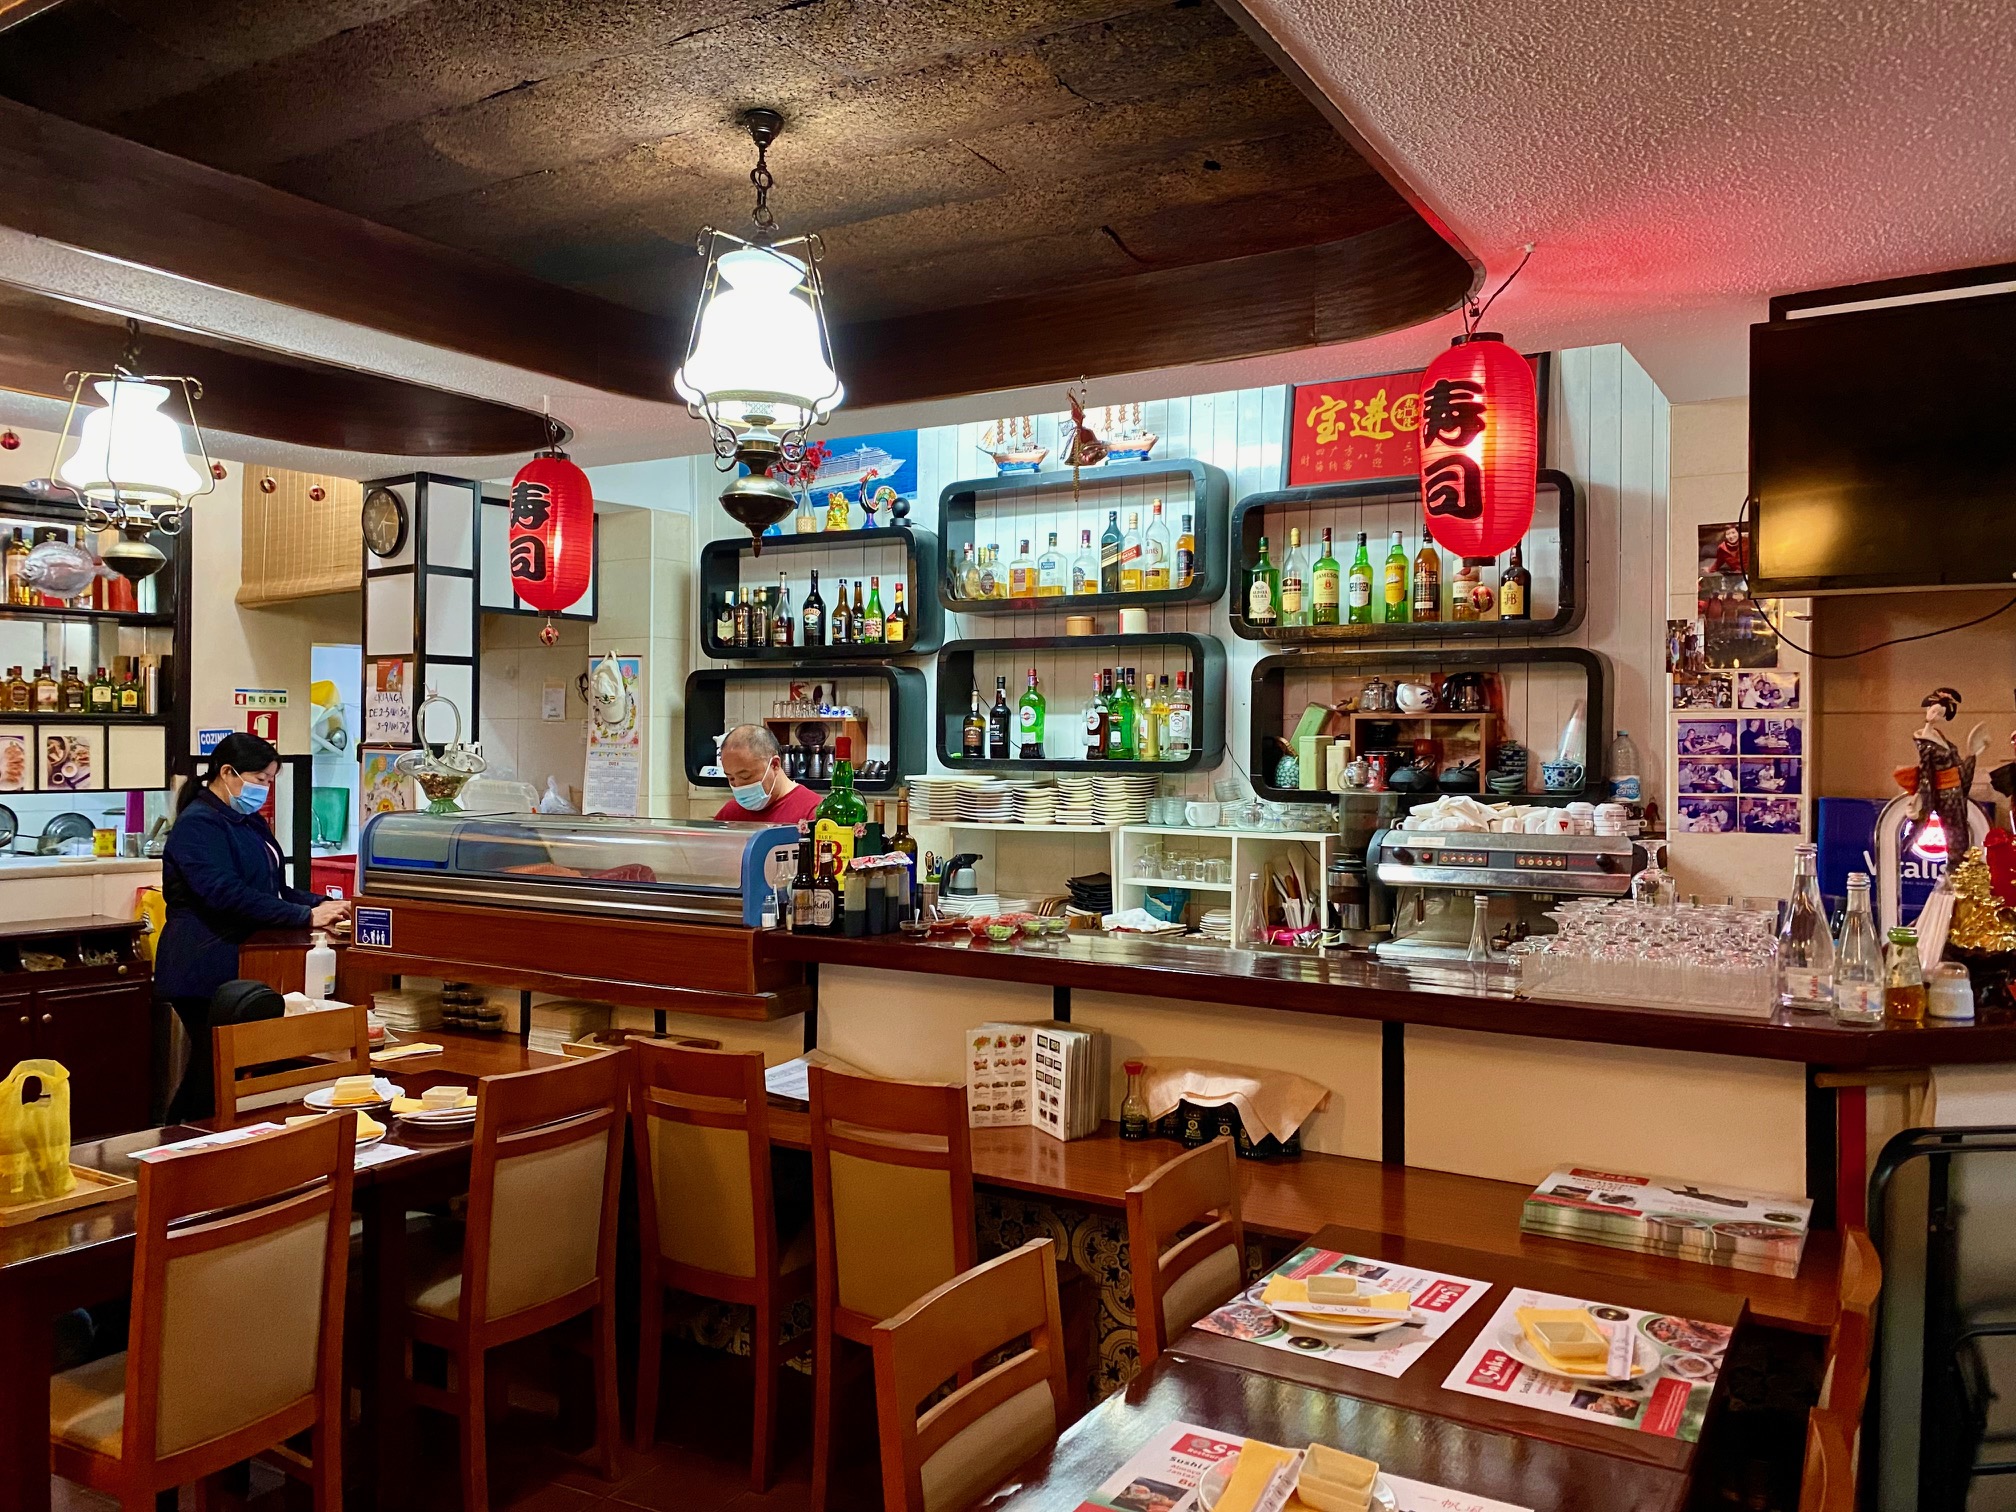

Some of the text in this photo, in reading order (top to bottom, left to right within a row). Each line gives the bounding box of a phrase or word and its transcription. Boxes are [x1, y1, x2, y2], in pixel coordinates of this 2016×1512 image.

[1423, 378, 1487, 520] 寿司
[510, 481, 551, 582] 寿司
[201, 731, 232, 745] COZINH
[1430, 1287, 1459, 1307] Saka
[1478, 1355, 1508, 1380] Saka
[1170, 1456, 1202, 1469] Sushi
